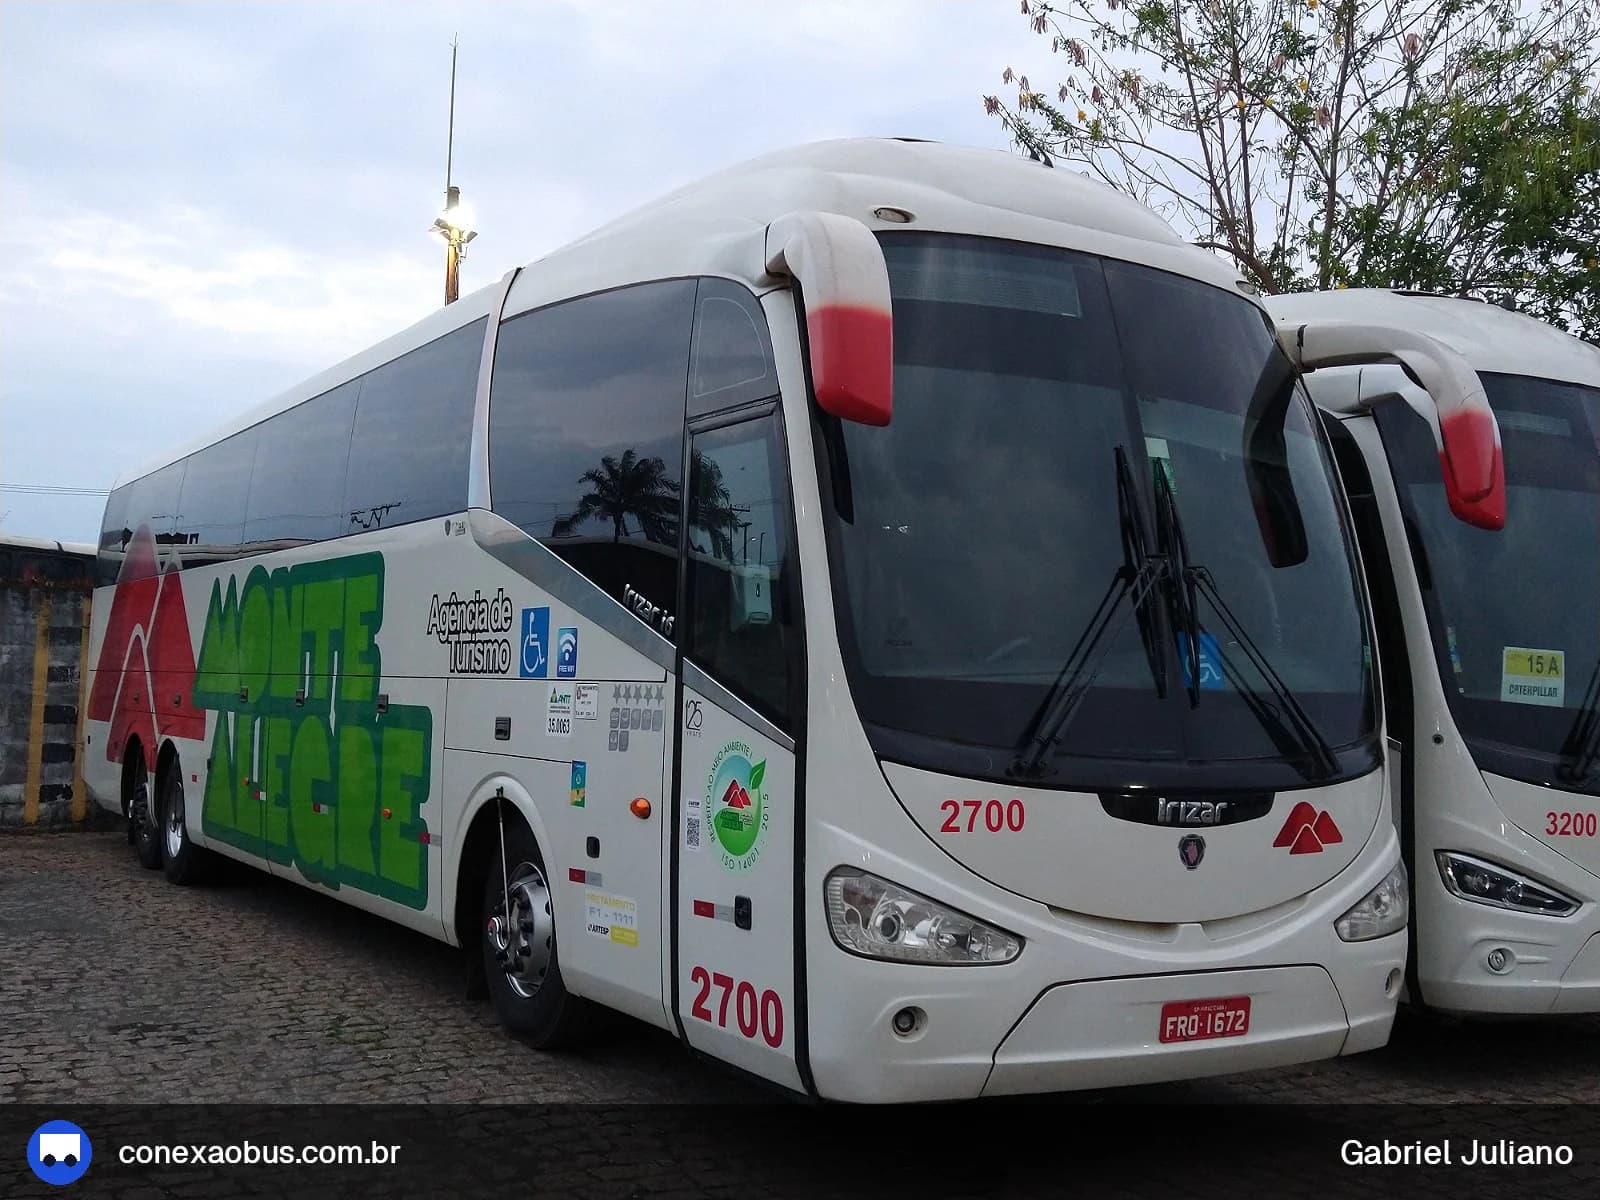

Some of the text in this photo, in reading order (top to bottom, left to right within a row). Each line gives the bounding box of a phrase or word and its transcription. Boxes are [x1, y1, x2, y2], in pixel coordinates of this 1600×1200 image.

[427, 588, 513, 644] Agência de
[661, 610, 675, 636] i6
[193, 552, 384, 714] MONTE
[447, 633, 512, 674] Turismo
[1528, 654, 1560, 675] 15 A
[557, 694, 572, 704] ANTT
[1509, 684, 1558, 697] CATERPILLAR
[202, 704, 432, 911] ALEGRE
[940, 799, 1025, 833] 2700
[1545, 811, 1597, 837] 3200
[721, 853, 735, 870] ISO
[691, 966, 784, 1049] 2700
